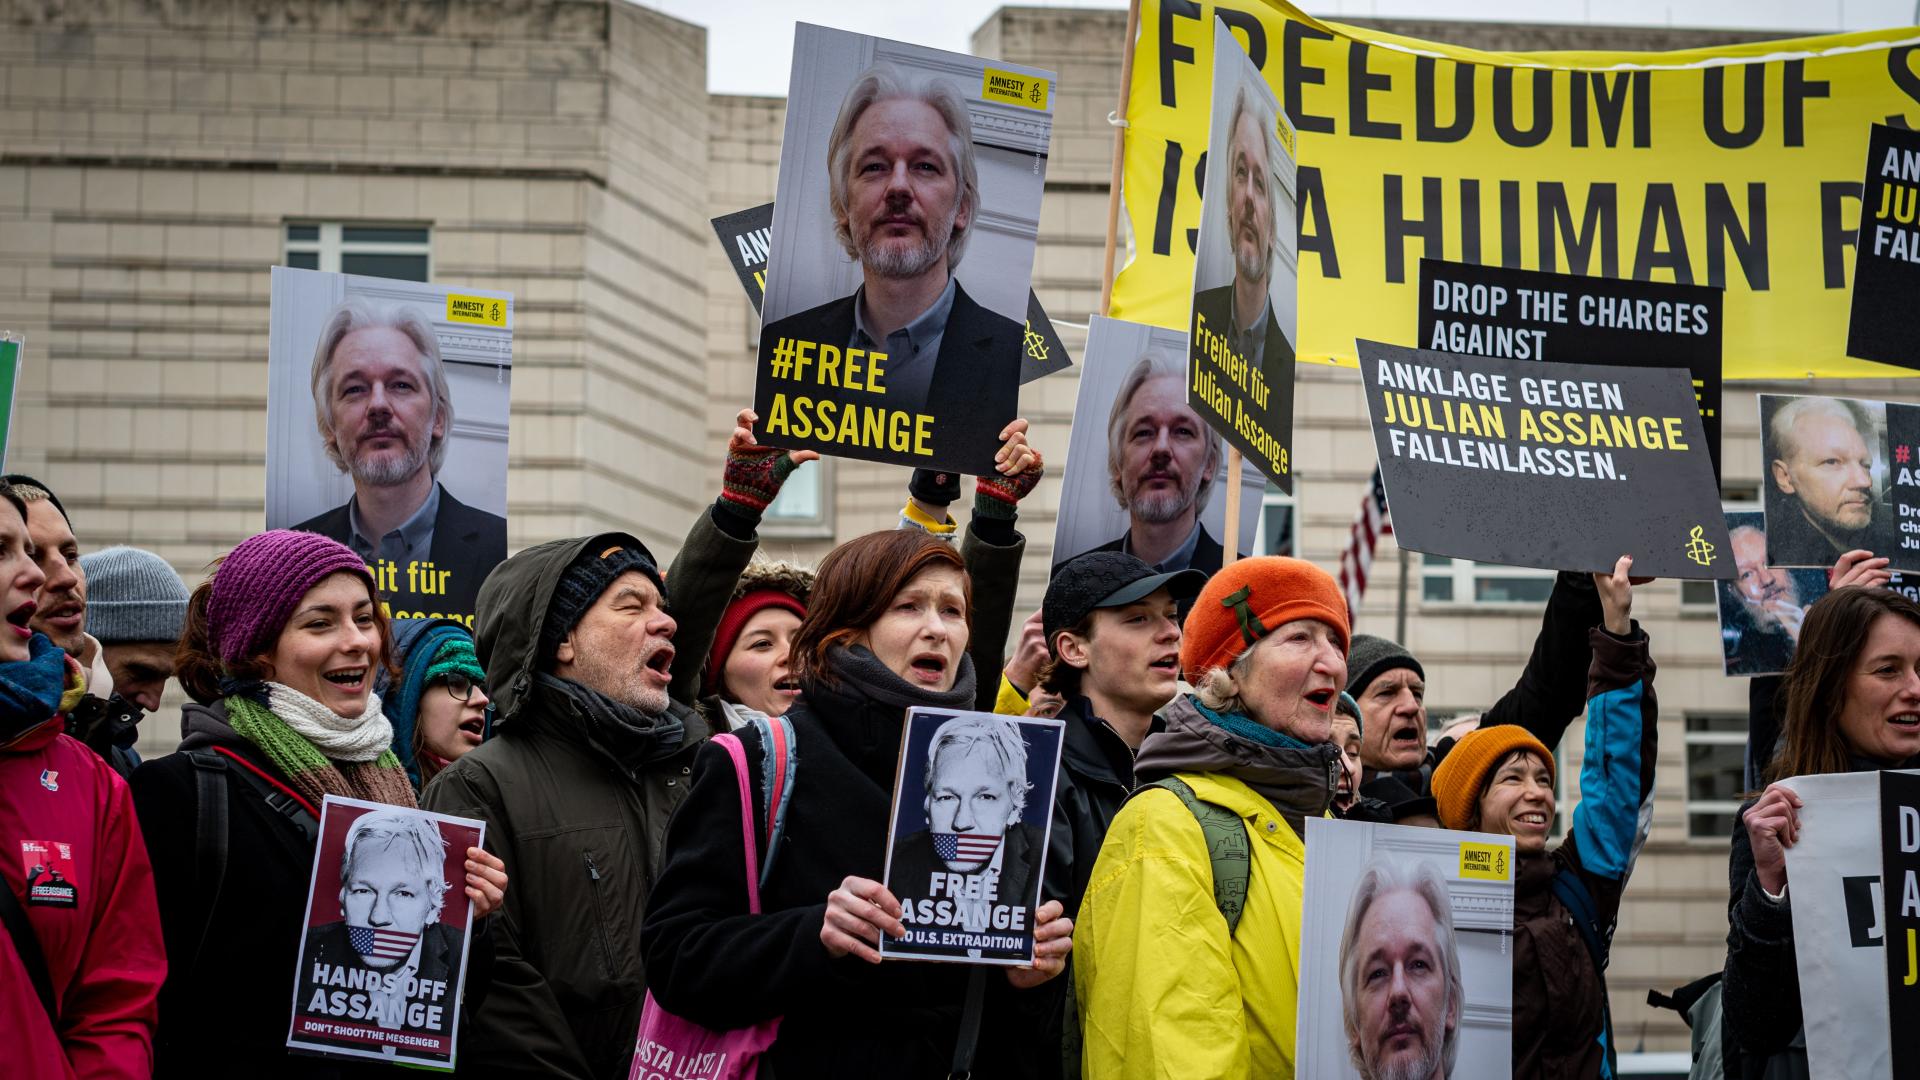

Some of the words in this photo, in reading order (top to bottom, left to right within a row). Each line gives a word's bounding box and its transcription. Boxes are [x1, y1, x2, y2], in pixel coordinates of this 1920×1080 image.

[989, 87, 1024, 99] INTERNATIONAL
[990, 76, 1025, 91] AMNESTY
[1383, 173, 1770, 292] HUMAN
[453, 300, 485, 312] AMNESTY
[1433, 279, 1507, 316] DROP
[1517, 288, 1568, 324] THE
[1578, 295, 1709, 335] CHARGES
[1431, 320, 1548, 361] AGAINST
[771, 337, 889, 394] #FREE
[1195, 311, 1248, 393] Freiheit
[1251, 366, 1270, 412] für
[1377, 359, 1512, 404] ANKLAGE
[1520, 376, 1624, 411] GEGEN
[766, 393, 935, 457] ASSANGE
[1193, 358, 1232, 424] Julian
[1234, 399, 1289, 476] Assange
[1383, 391, 1506, 440] JULIAN
[1520, 408, 1689, 451] ASSANGE
[1389, 429, 1627, 482] FALLENLASSEN.
[407, 560, 451, 596] für
[1464, 850, 1491, 862] AMNESTY
[1464, 863, 1491, 872] INTERNATIONAL
[929, 871, 999, 901] FREE
[900, 898, 1027, 931] ASSANGE
[916, 931, 940, 945] U.S.
[942, 933, 1024, 949] EXTRADITION
[312, 963, 397, 995] HANDS
[403, 979, 448, 1001] OFF
[306, 988, 444, 1031] ASSANGE
[304, 1021, 333, 1034] DON'T
[333, 1026, 366, 1038] SHOOT
[366, 1030, 385, 1041] THE
[386, 1033, 440, 1049] MESSENGER
